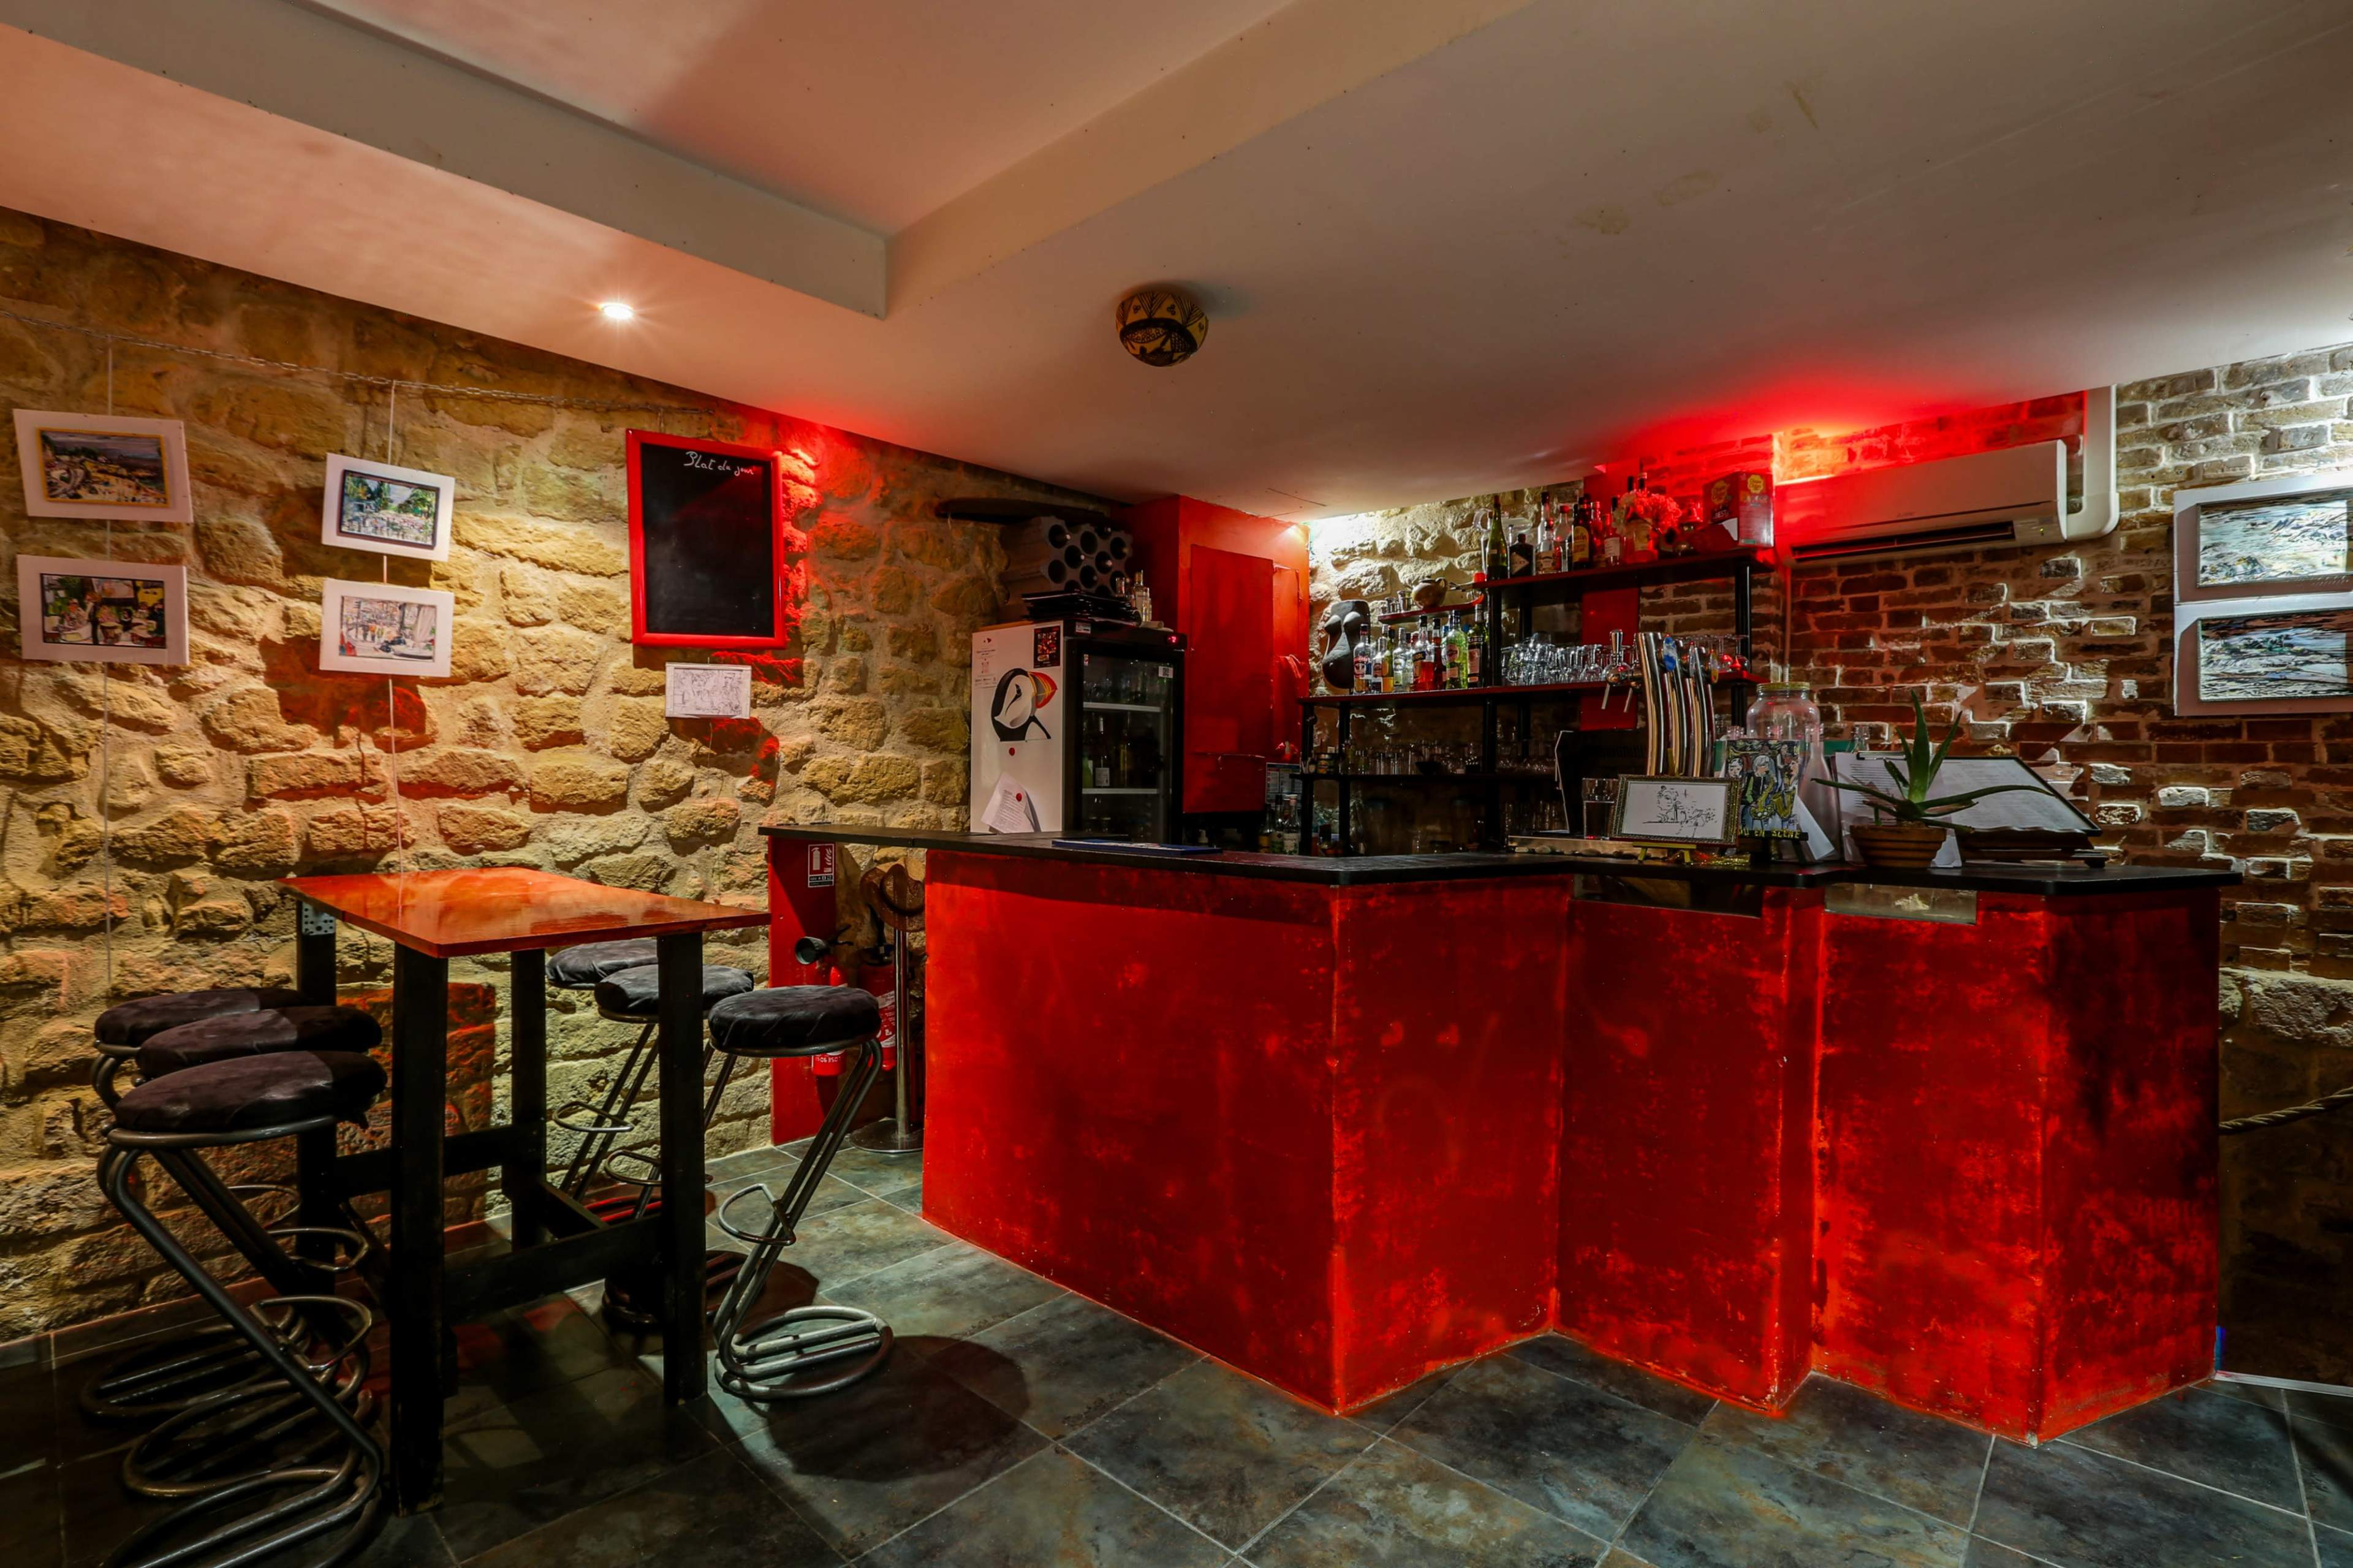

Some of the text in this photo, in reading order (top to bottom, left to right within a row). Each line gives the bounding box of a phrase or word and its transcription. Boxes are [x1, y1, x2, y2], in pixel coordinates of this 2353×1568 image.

[683, 451, 754, 476] Plat du jour
